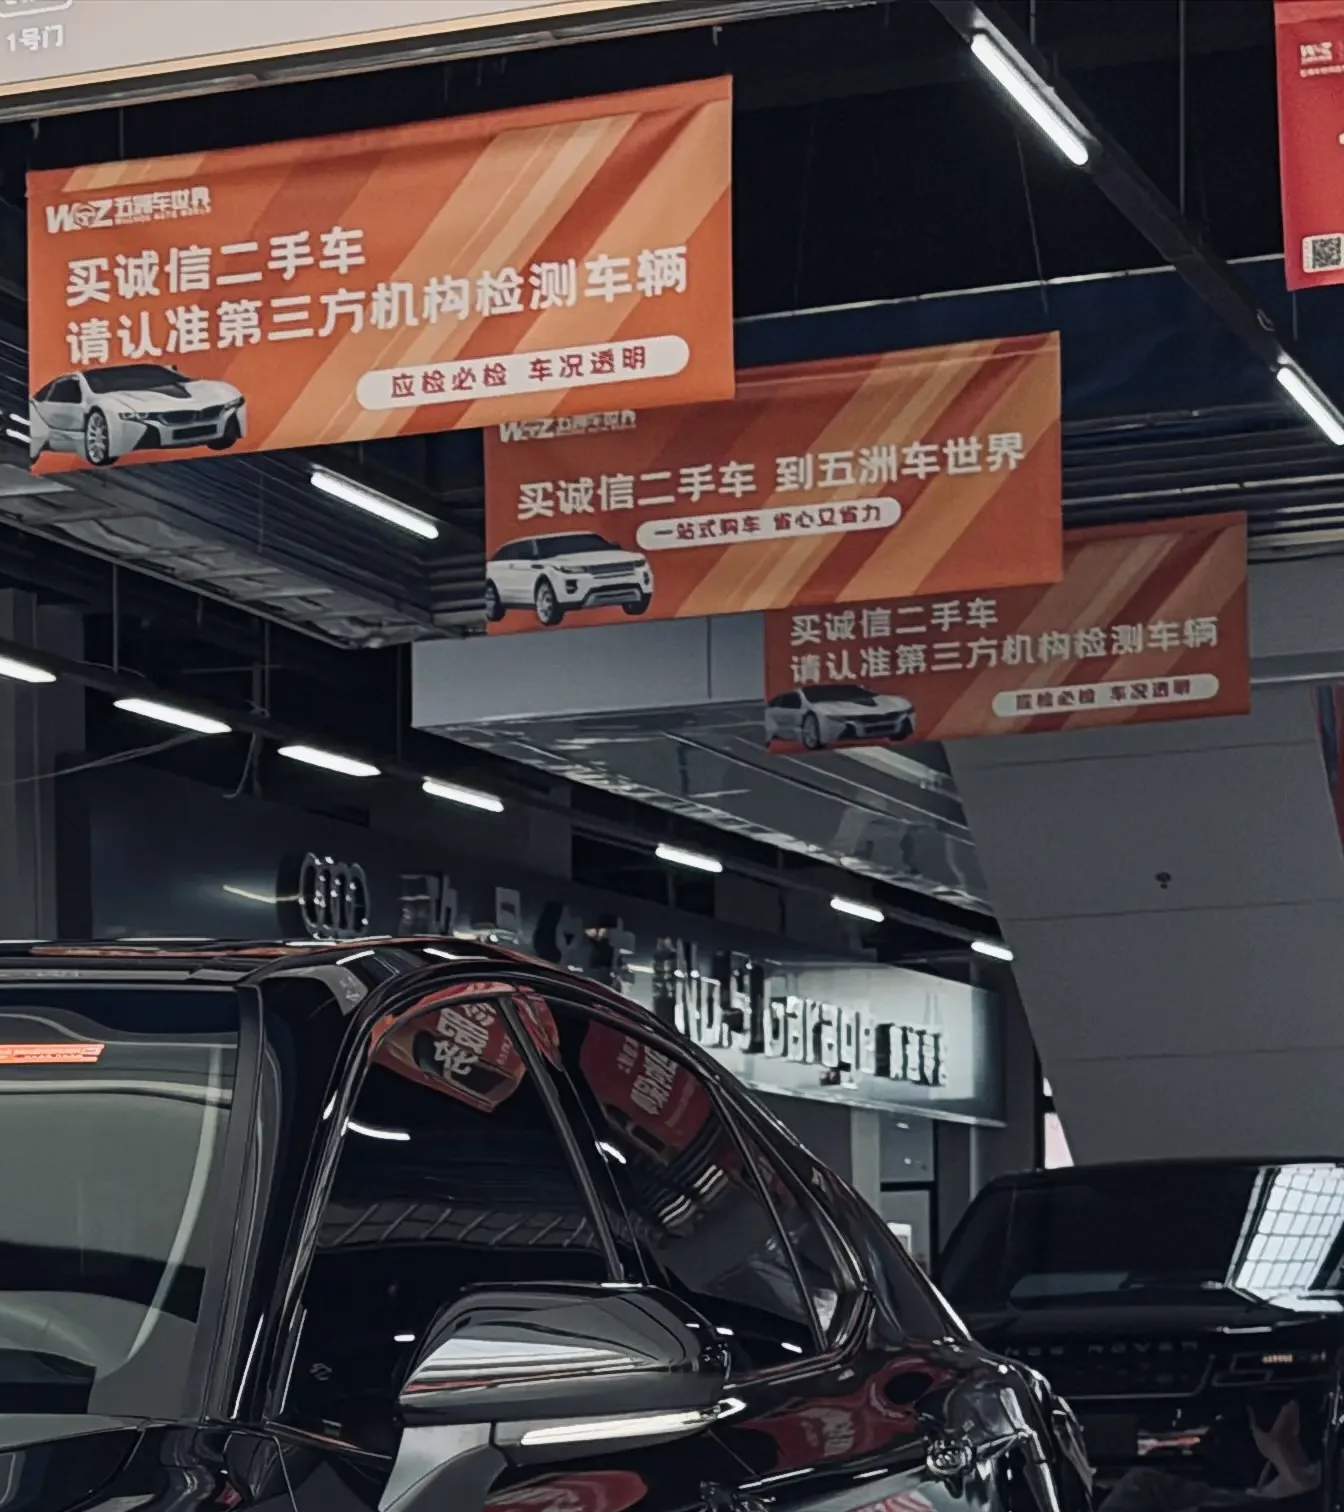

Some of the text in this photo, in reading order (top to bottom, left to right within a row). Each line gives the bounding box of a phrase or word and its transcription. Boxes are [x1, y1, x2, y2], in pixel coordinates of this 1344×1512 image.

[6, 24, 63, 51] 1号门
[65, 225, 368, 308] 买诚信二手车
[65, 246, 690, 367] 请认准第三方机构检测车辆
[390, 346, 647, 399] 应检必检 车况透明
[516, 432, 1026, 520] 买诚信二手车 到五洲车世界
[654, 503, 882, 540] 一站式购车 省心又省力
[790, 597, 999, 646] 买诚信二手车
[790, 616, 1219, 684] 请认准第三方机构检测车辆
